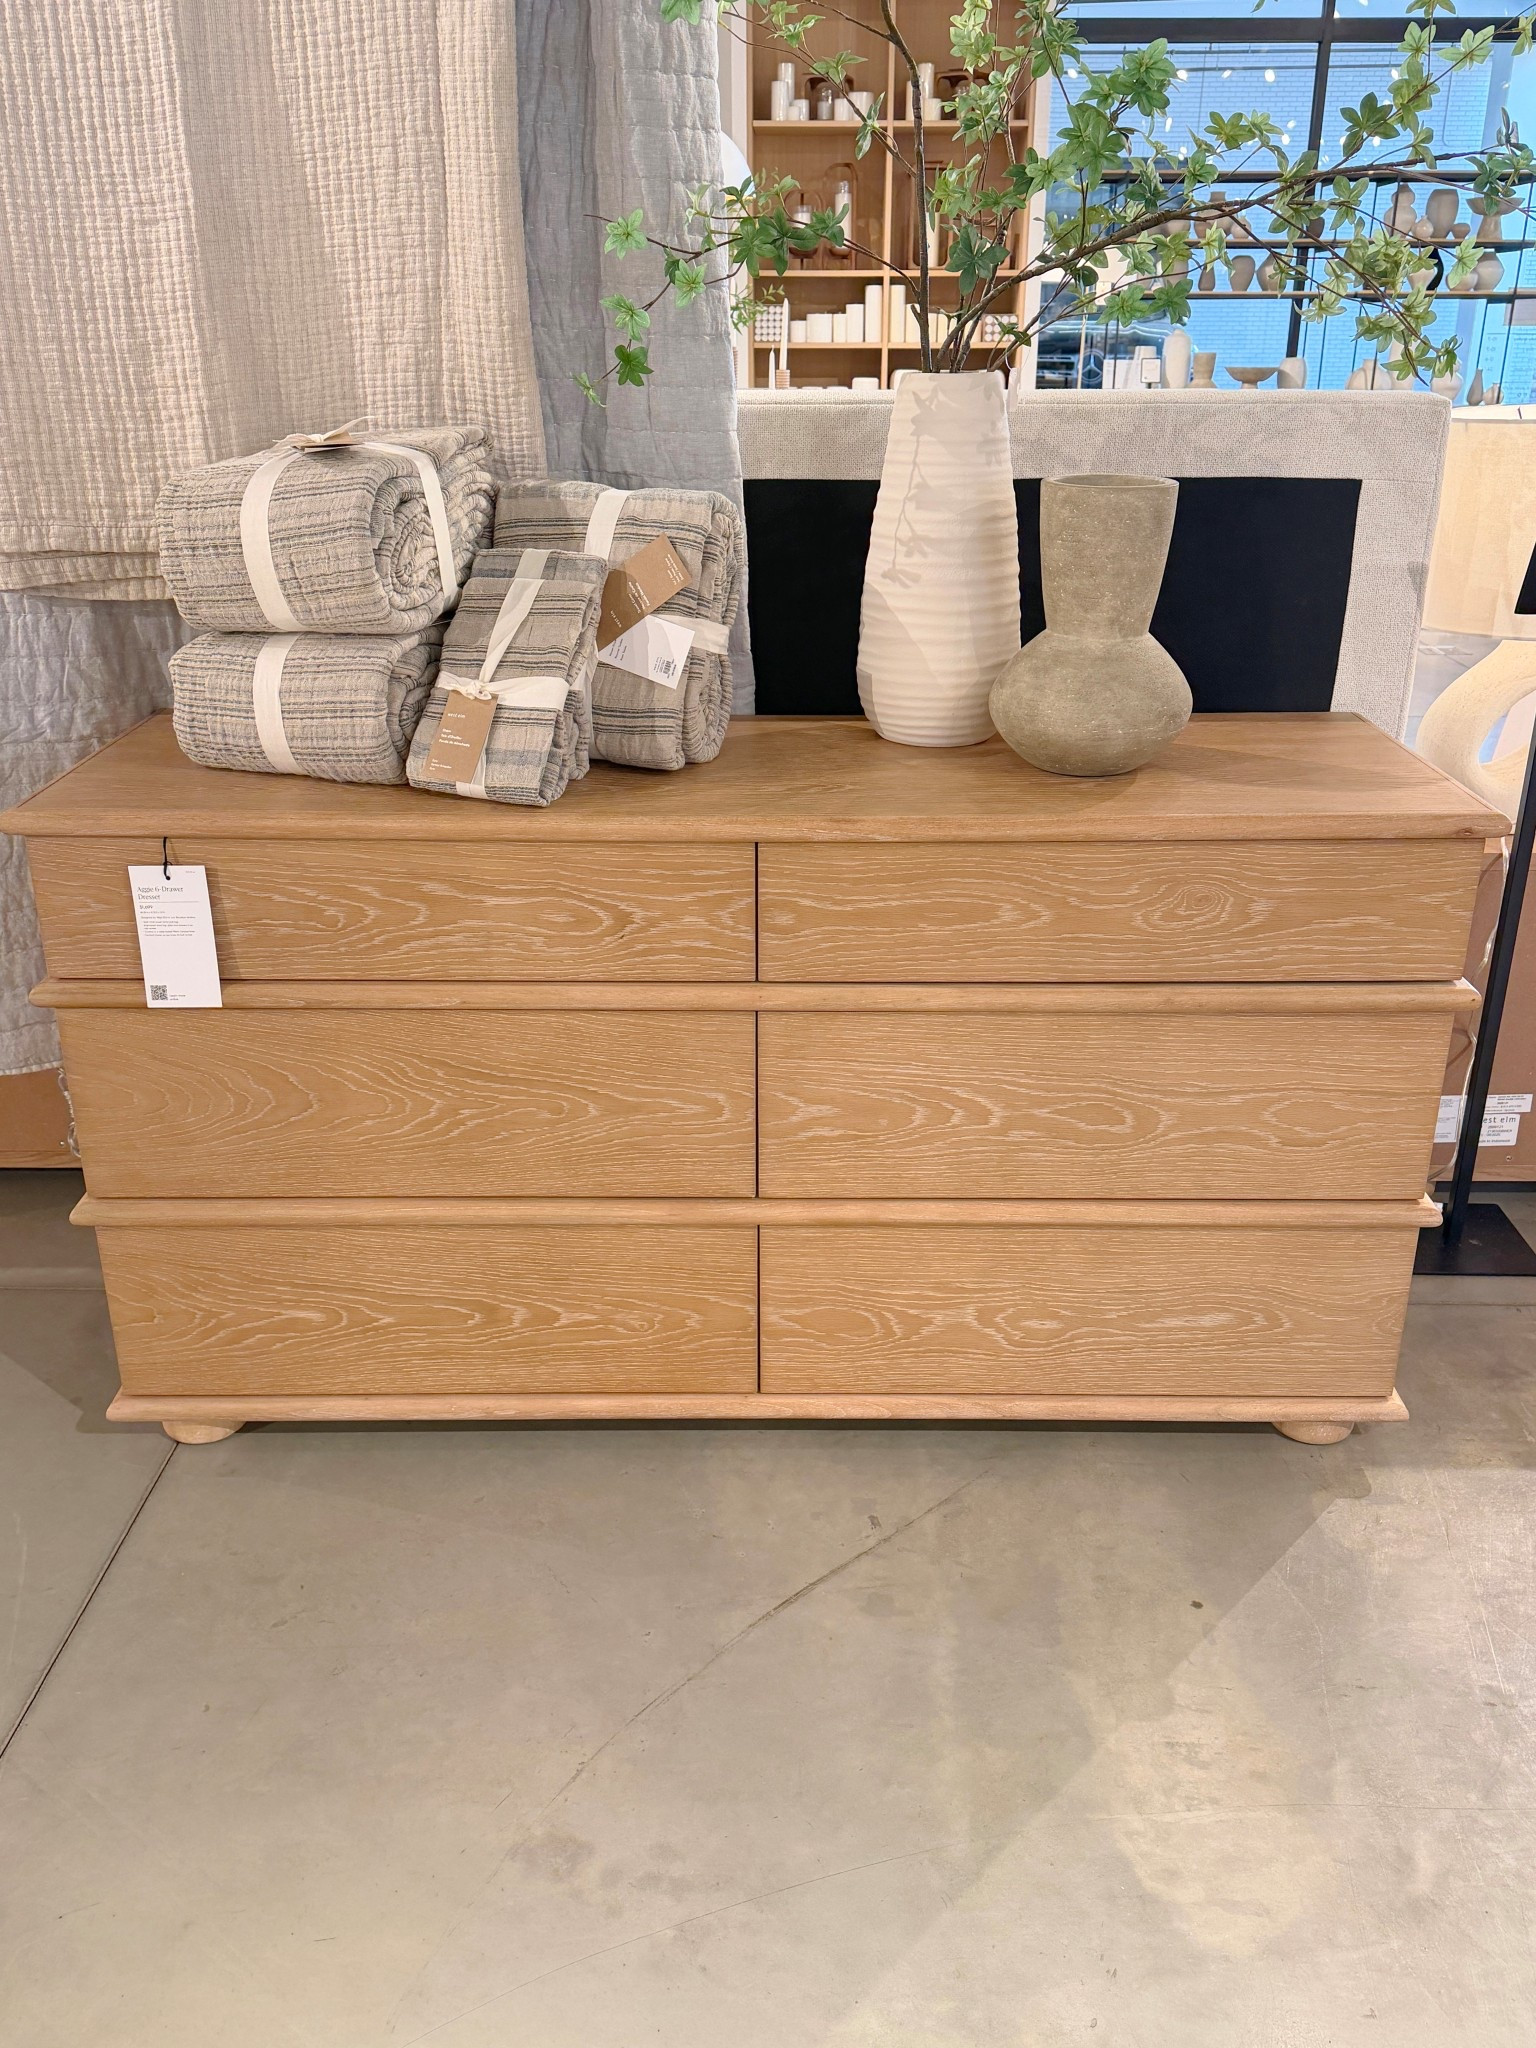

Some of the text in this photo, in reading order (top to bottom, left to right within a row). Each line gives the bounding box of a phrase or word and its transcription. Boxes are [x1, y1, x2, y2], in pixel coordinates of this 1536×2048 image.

[137, 886, 154, 894] Aggie
[138, 893, 160, 901] Dresser
[1481, 1116, 1497, 1124] est
